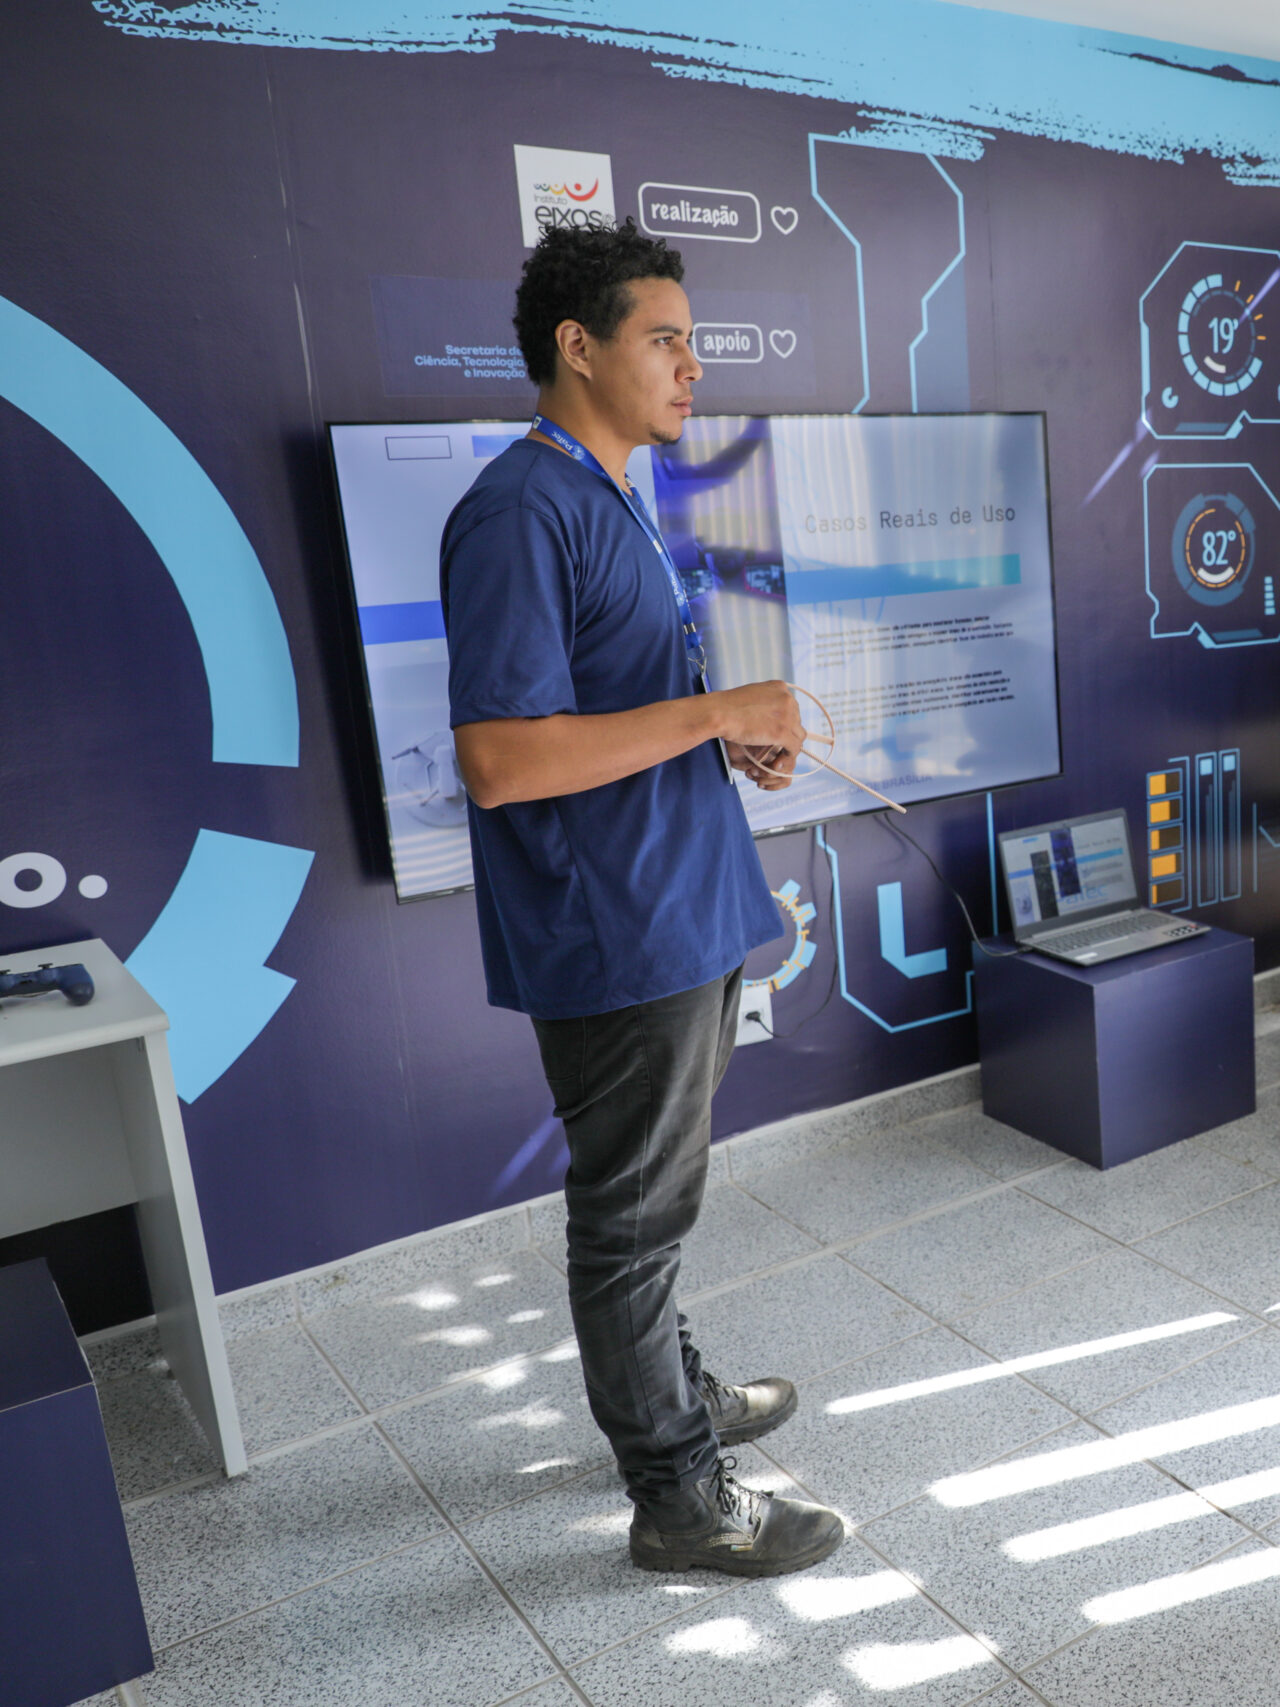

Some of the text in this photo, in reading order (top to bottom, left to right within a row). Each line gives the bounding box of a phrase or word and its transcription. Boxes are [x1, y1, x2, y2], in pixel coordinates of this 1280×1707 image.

[651, 200, 739, 228] realização
[445, 344, 507, 356] Secretaria
[703, 330, 751, 355] apoio
[414, 355, 525, 369] Ciência, Tecnologia
[464, 366, 526, 380] e Inovação
[805, 504, 1016, 534] Casos Reais de Uso
